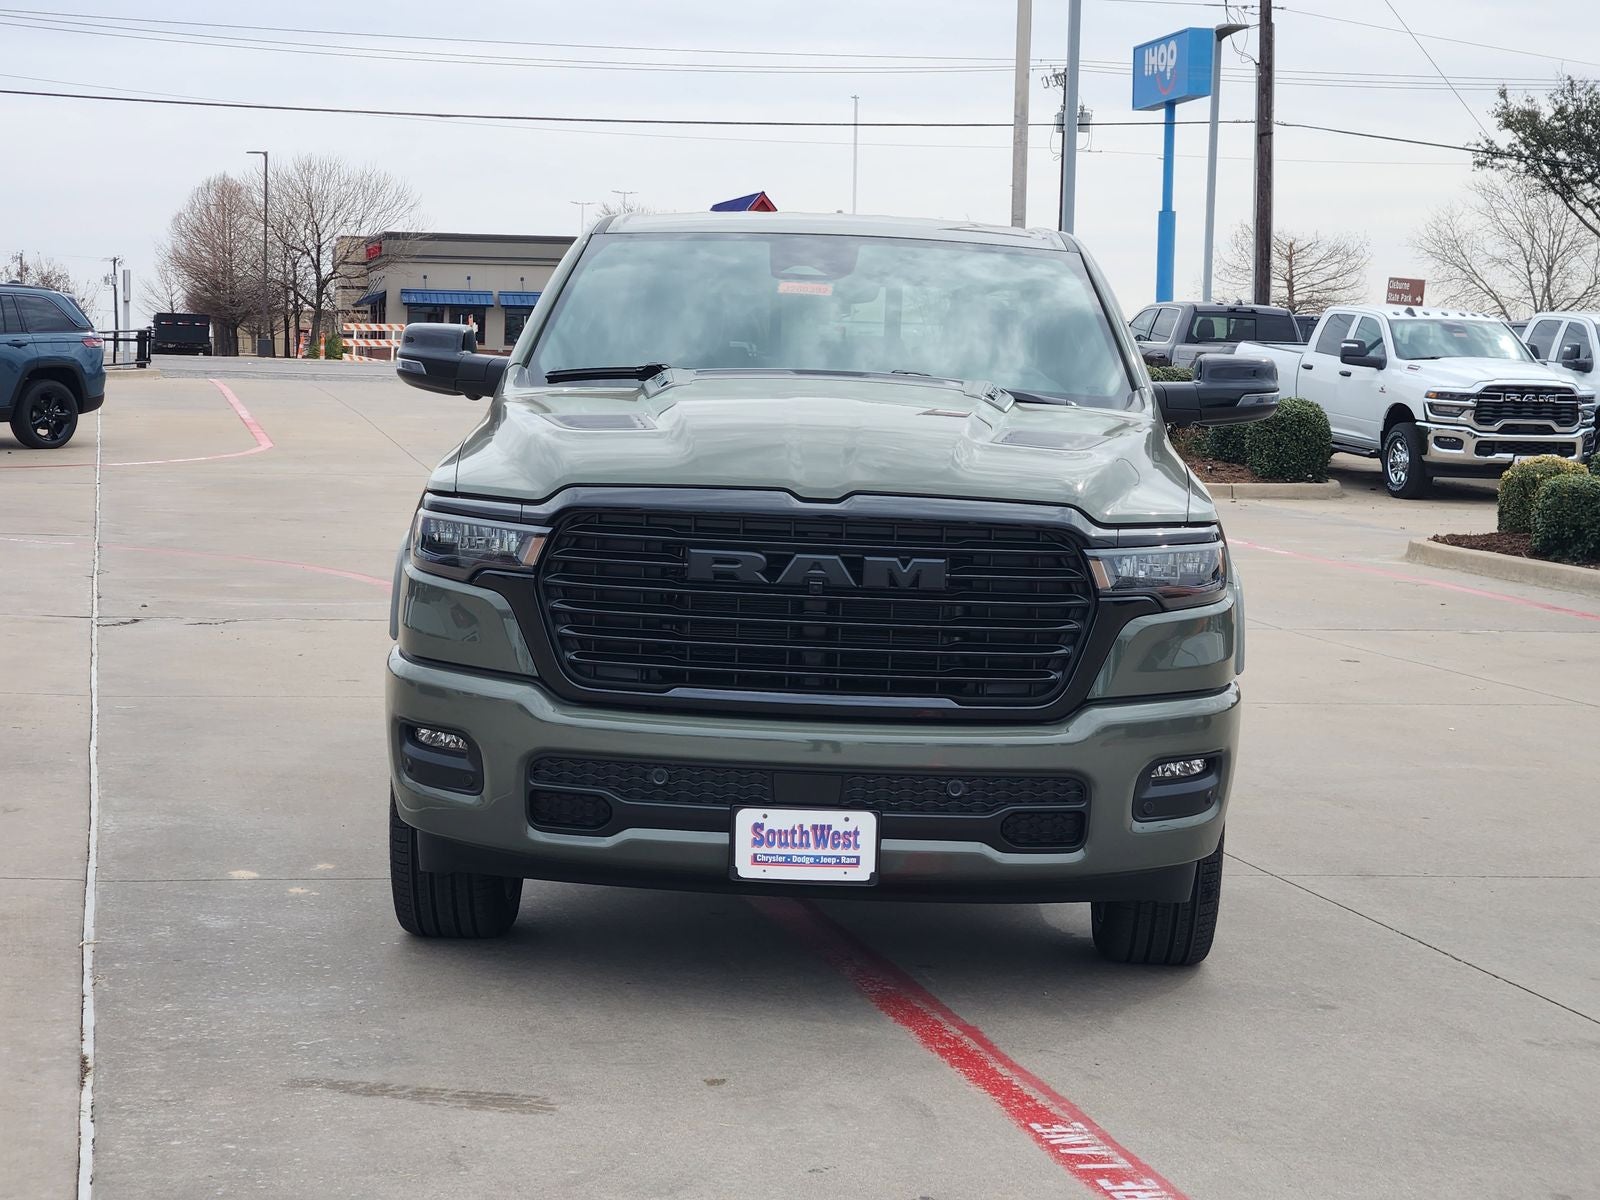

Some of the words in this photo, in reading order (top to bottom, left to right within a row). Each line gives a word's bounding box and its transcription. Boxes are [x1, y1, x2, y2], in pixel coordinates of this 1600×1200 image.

[1144, 40, 1177, 80] IHOP
[1389, 280, 1410, 290] Cleburne
[1388, 292, 1399, 301] State
[1401, 293, 1412, 302] Park
[1505, 393, 1555, 402] RAM
[687, 548, 947, 591] RAM
[756, 854, 786, 863] Chrysler
[792, 855, 815, 864] Dodge
[820, 857, 837, 865] Jeep
[1029, 1121, 1133, 1169] LANE
